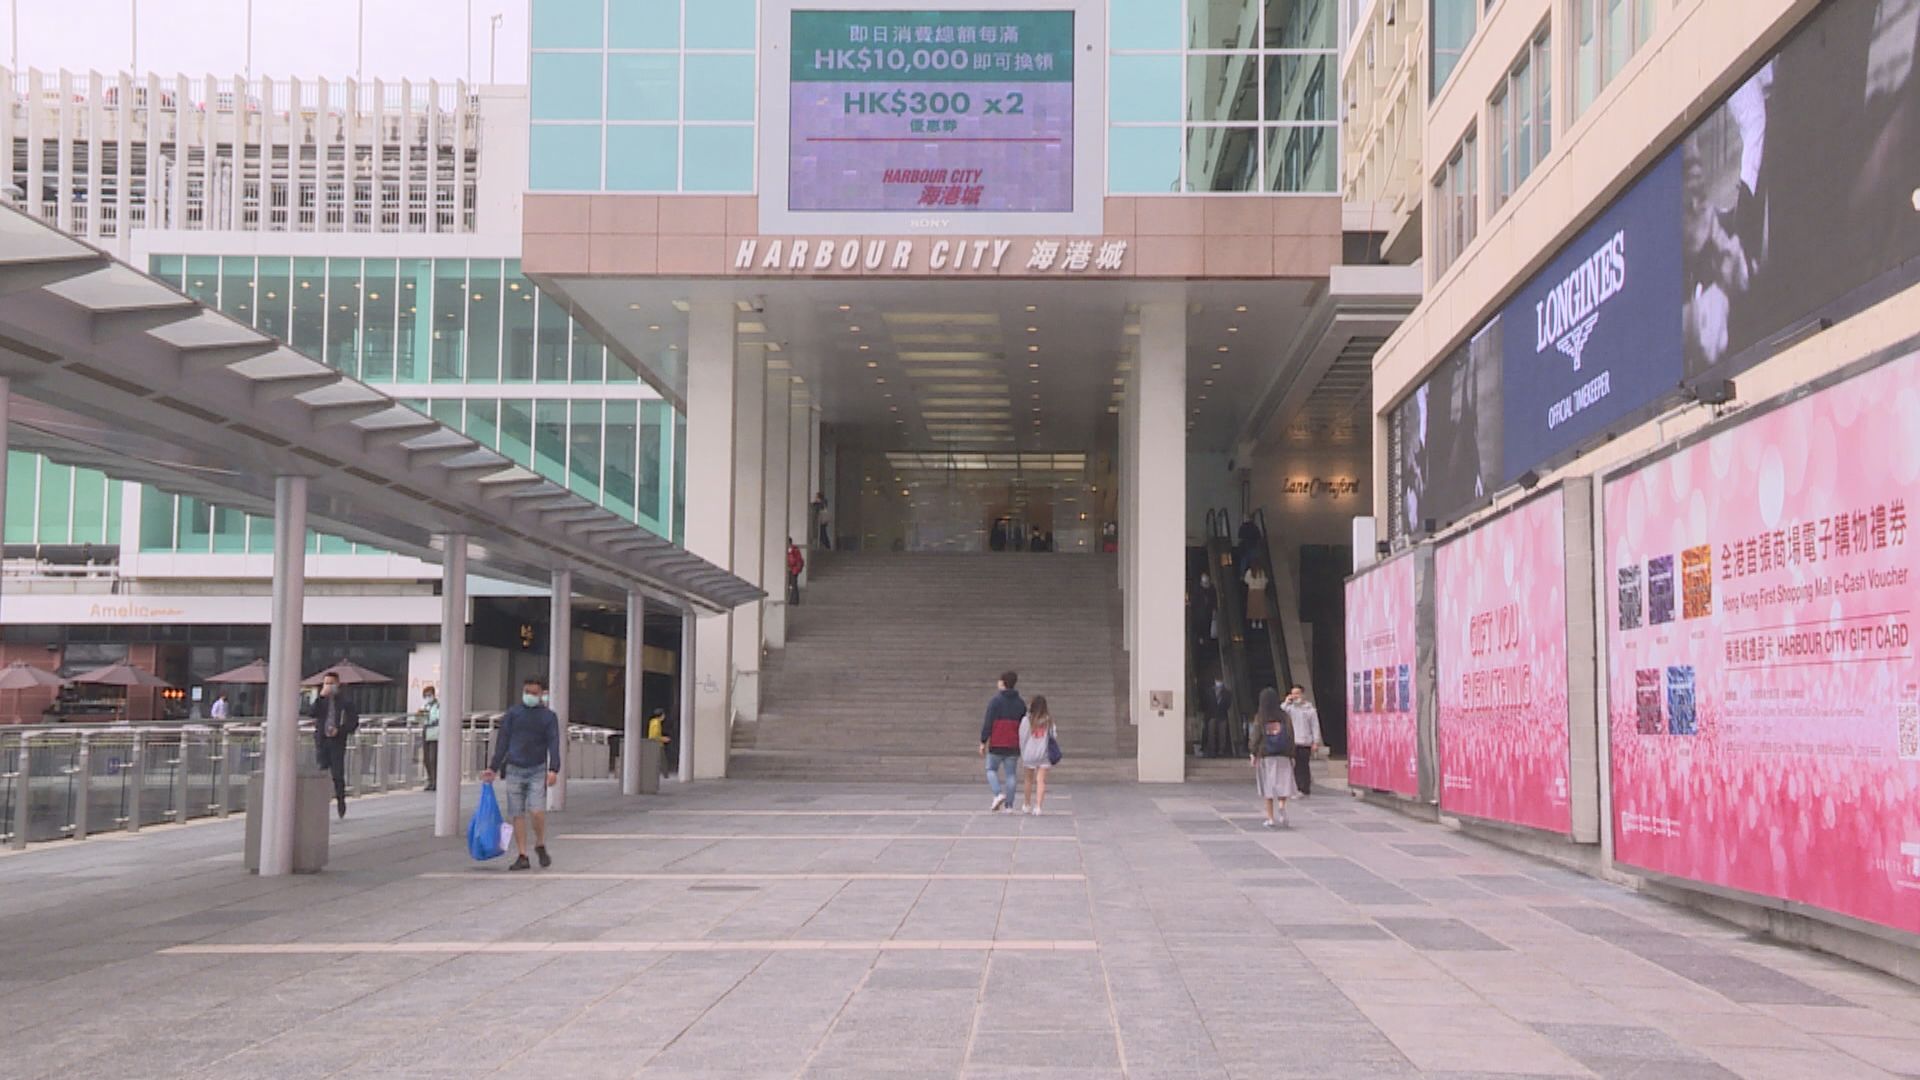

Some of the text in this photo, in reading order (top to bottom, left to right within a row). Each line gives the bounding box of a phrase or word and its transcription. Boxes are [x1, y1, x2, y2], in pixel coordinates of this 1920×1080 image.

[814, 47, 969, 73] HK$10,000
[843, 90, 1025, 118] HK$300 x2
[882, 167, 984, 184] HARBOUR CITY
[917, 185, 985, 206] 海港城
[733, 239, 1129, 271] HARBOUR CITY 海港城
[1536, 229, 1626, 354] LONGINES
[1548, 369, 1611, 430] OFFICIAL TIMEKEEPER
[1281, 477, 1309, 494] Lane
[1722, 593, 1740, 616] Hong
[1740, 591, 1758, 612] Kong
[1759, 586, 1776, 607] First
[1815, 576, 1833, 598] Mall
[1834, 570, 1866, 595] e-Cash
[1867, 564, 1909, 590] Voucher
[1777, 631, 1823, 658] HARBOUR
[1824, 629, 1848, 654] CITY
[1850, 625, 1874, 651] GIFT
[1875, 622, 1909, 649] CARD
